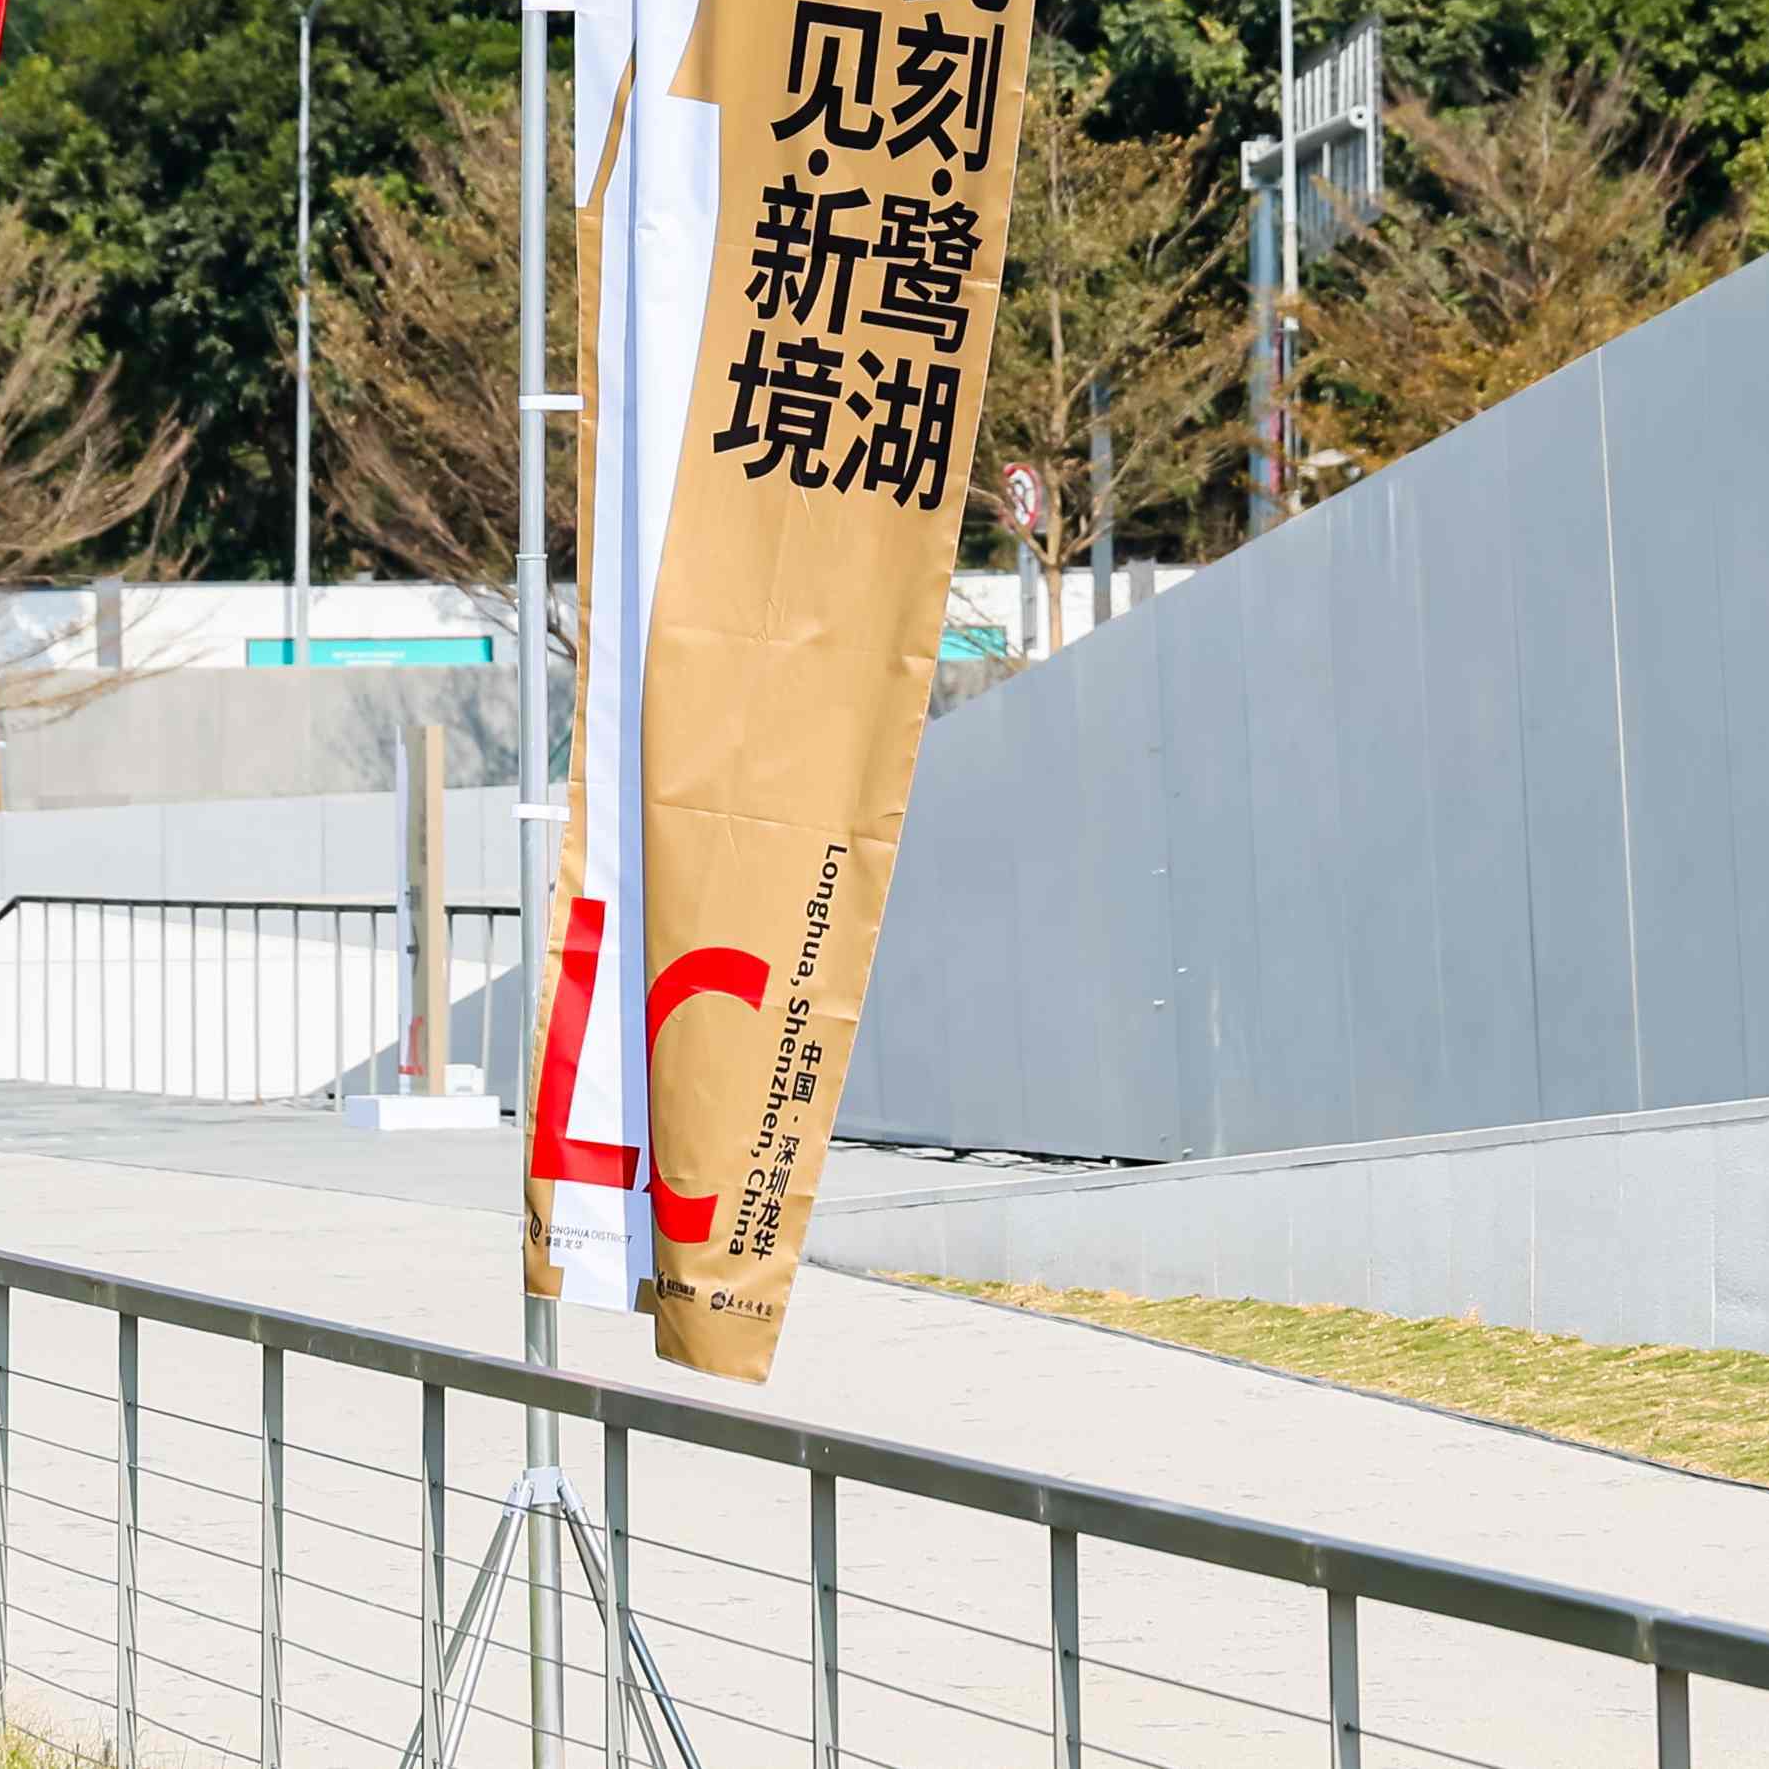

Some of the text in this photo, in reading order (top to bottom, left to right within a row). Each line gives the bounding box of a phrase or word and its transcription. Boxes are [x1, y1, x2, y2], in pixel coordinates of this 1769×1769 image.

[790, 842, 848, 987] Longhua,
[531, 896, 771, 1245] LC
[749, 997, 811, 1159] Shenzhen,
[728, 1167, 768, 1258] China
